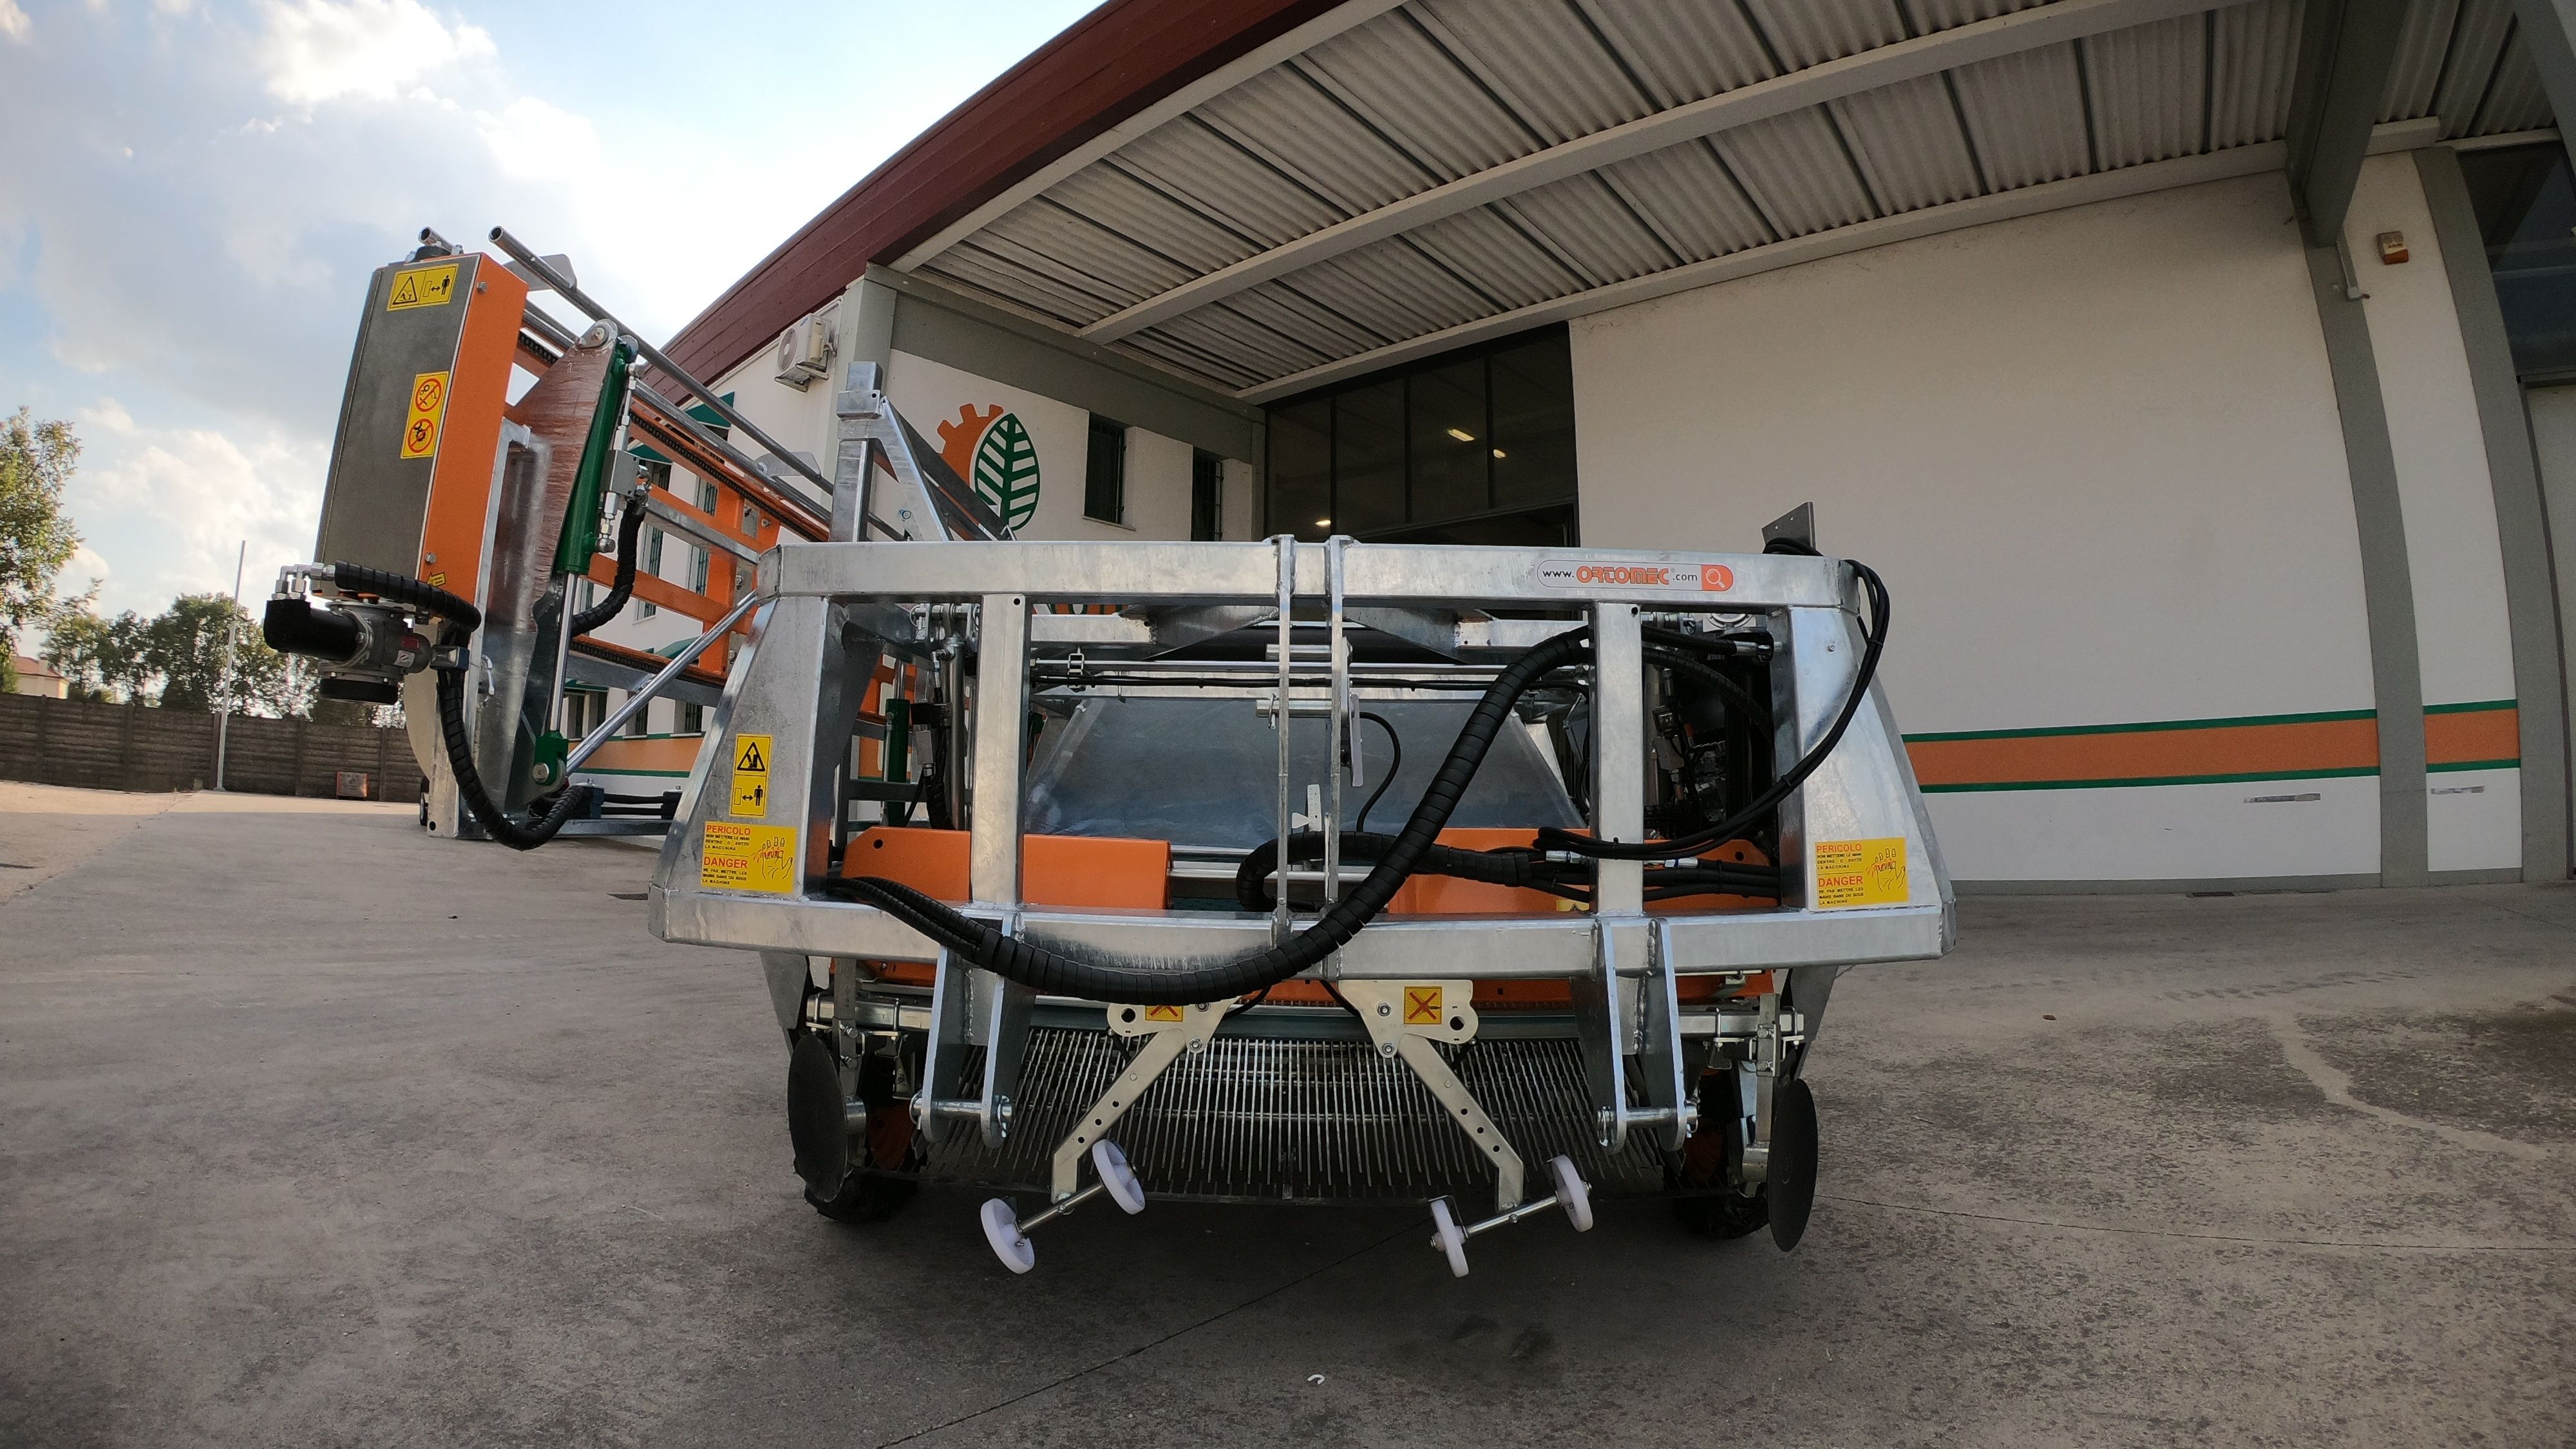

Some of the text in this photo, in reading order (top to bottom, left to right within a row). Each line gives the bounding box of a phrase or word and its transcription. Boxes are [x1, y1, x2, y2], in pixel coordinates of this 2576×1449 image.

[706, 825, 751, 835] PERICOLO
[1816, 843, 1862, 853] PERICOLO
[704, 857, 748, 869] DANGER
[1819, 876, 1863, 887] DANGER
